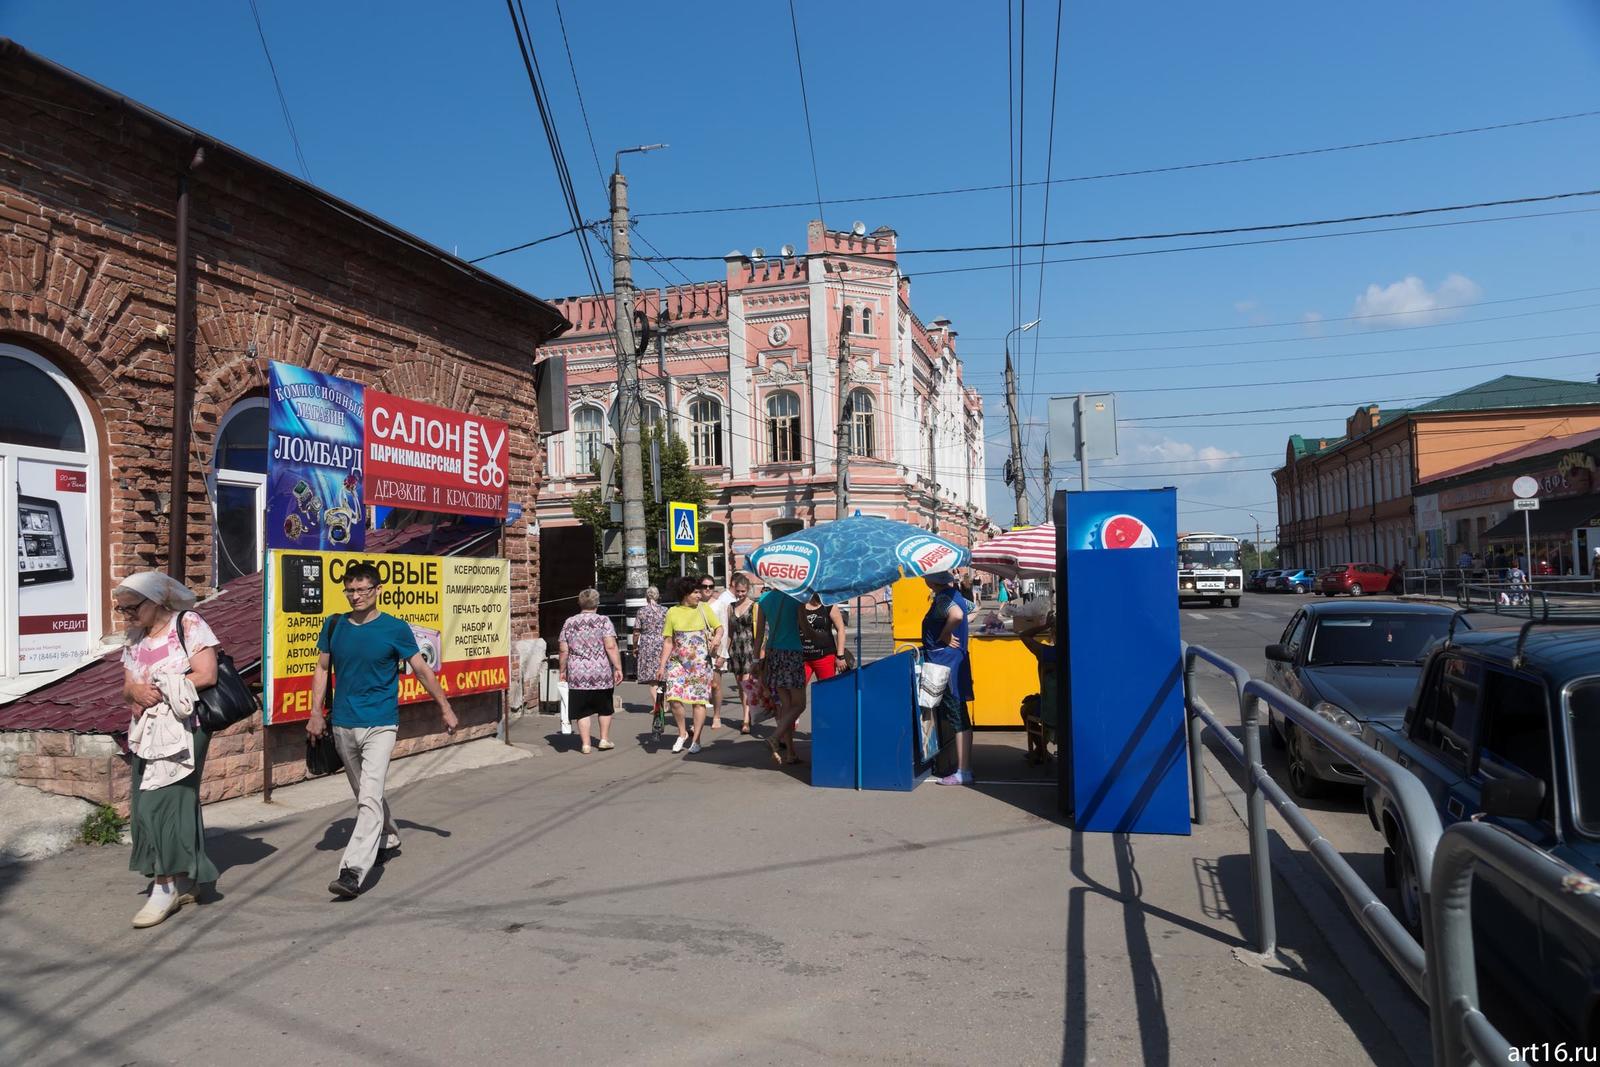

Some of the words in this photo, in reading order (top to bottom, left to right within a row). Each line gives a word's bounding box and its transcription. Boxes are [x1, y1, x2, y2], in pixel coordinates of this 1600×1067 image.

[275, 382, 364, 419] КОМИССИОННЫЙ
[296, 402, 345, 426] МАГАЗИН
[371, 406, 460, 452] САЛОН
[274, 434, 363, 475] ЛОМБАРД
[370, 442, 461, 474] ПАРИКМАХЕРСКАЯ
[374, 480, 426, 502] ДЕРЗКИЕ
[433, 487, 440, 504] И
[447, 488, 502, 511] КРАСИВЫЕ
[454, 565, 500, 575] КСЕРОКОПИЯ
[446, 584, 507, 594] ЛАМИНИРОВАНИЕ
[452, 604, 480, 614] ПЕЧАТЬ
[481, 603, 502, 613] ФОТО
[52, 620, 86, 630] КРЕДИТ
[461, 622, 486, 632] НАБОР
[487, 621, 493, 631] И
[287, 632, 321, 645] ЦИФРО
[455, 633, 500, 645] РАСПЕЧАТКА
[464, 646, 491, 657] ТЕКСТА
[456, 667, 507, 690] СКУПКА
